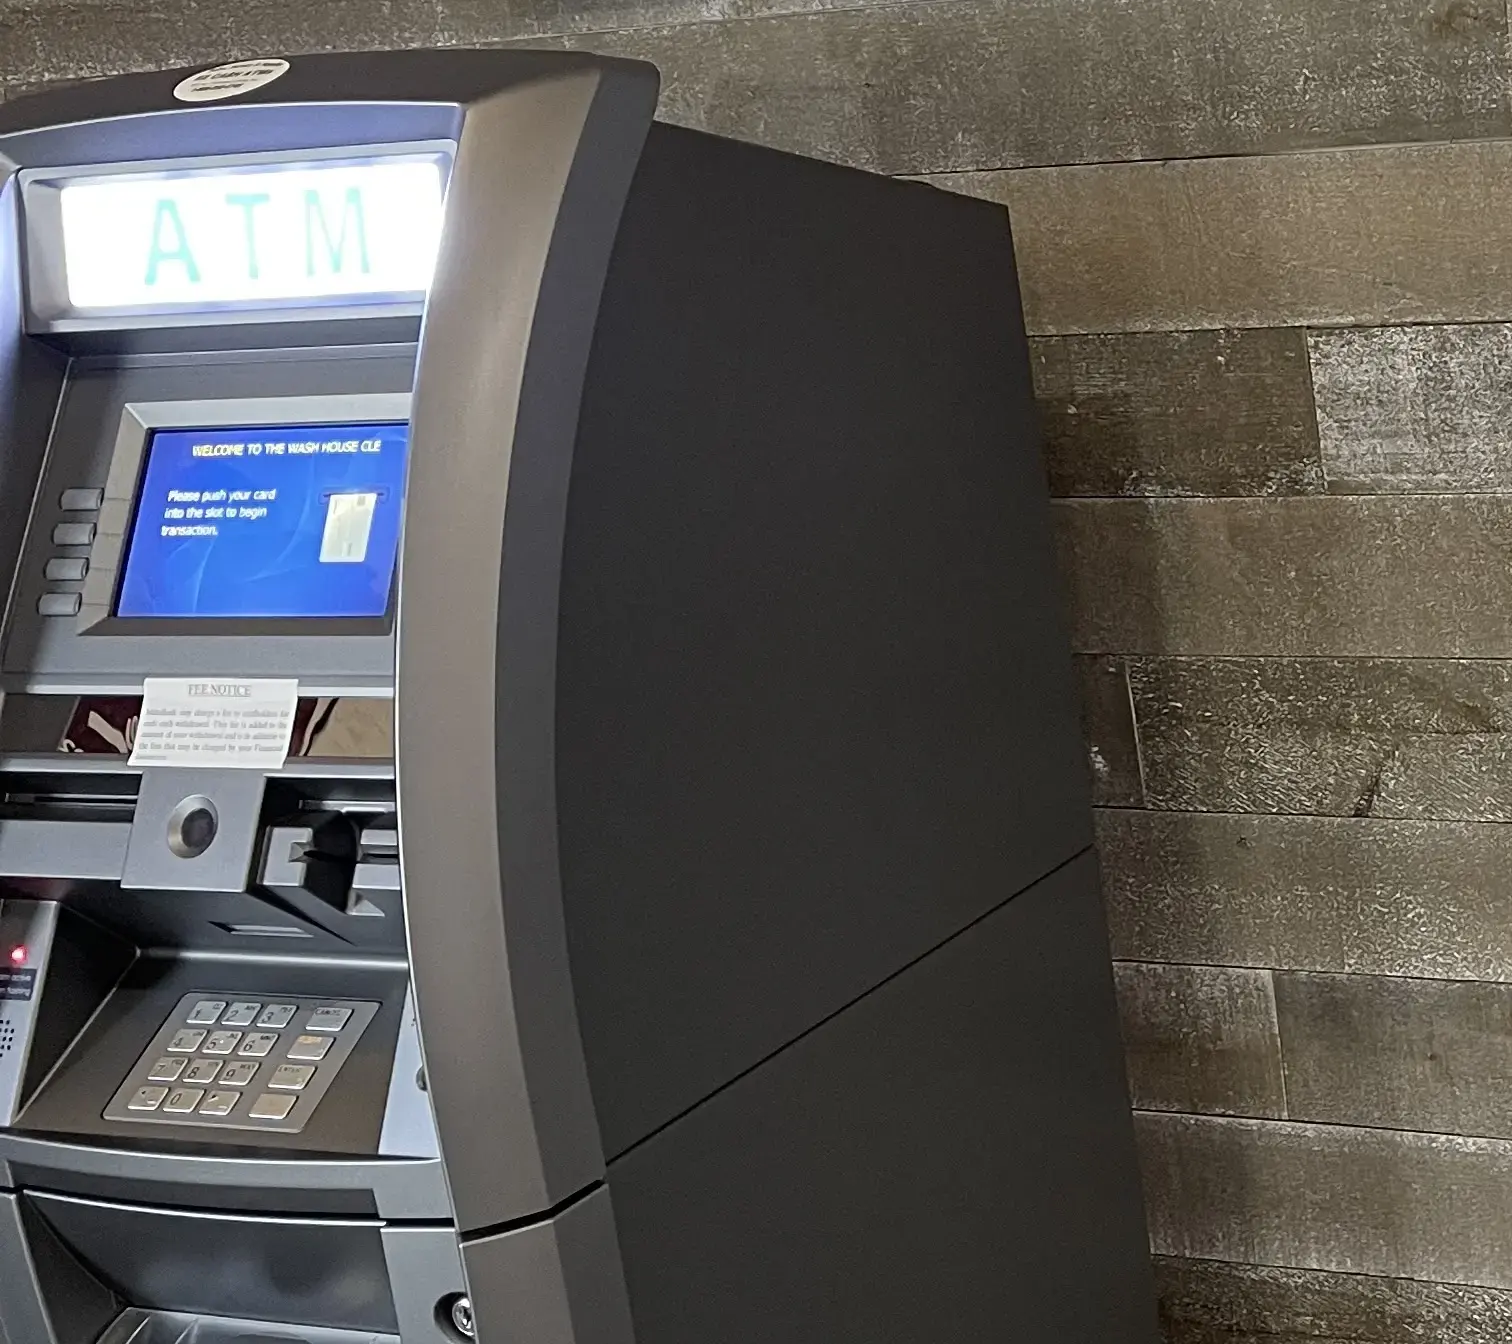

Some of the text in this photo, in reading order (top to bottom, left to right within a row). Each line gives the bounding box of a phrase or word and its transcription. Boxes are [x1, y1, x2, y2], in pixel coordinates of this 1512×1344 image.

[144, 187, 371, 286] ATM
[193, 443, 244, 457] WELCOME
[247, 443, 262, 455] TO
[265, 443, 285, 455] THE
[288, 441, 319, 454] WASH
[321, 441, 359, 453] HOUSE
[167, 488, 277, 503] Please push your card
[164, 507, 267, 520] into the slot to begin
[161, 525, 218, 536] transaction.
[188, 683, 252, 697] FEE NOTICE
[226, 1009, 239, 1022] 2
[261, 1011, 274, 1024] 3
[206, 1037, 219, 1050] 5
[243, 1039, 256, 1052] 6
[187, 1066, 200, 1079] 8
[223, 1068, 236, 1081] 9
